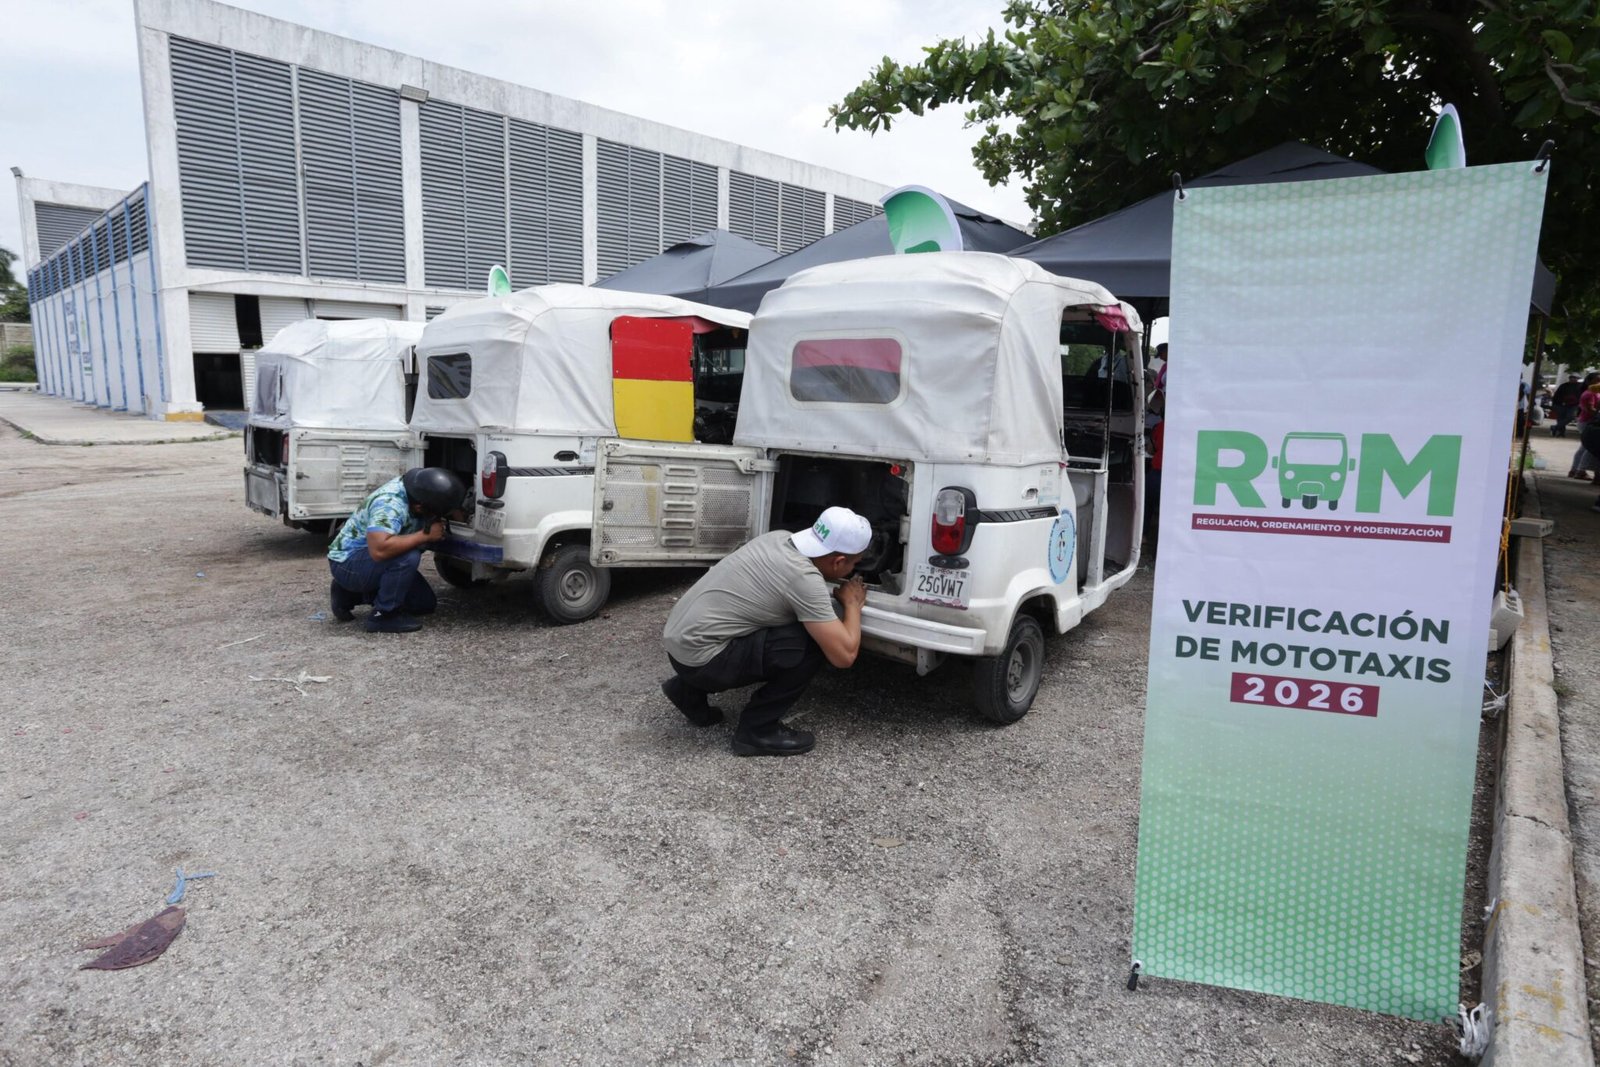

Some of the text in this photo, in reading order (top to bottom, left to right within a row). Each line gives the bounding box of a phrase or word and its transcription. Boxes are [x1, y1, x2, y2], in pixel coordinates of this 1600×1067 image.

[1196, 518, 1444, 538] REGULACIÓN, ORDENAMIENTO Y MODERNIZACIÓN
[1182, 599, 1450, 644] VERIFICACIÓN
[1175, 635, 1452, 683] DE MOTOTAXIS
[1243, 677, 1364, 712] 2026
